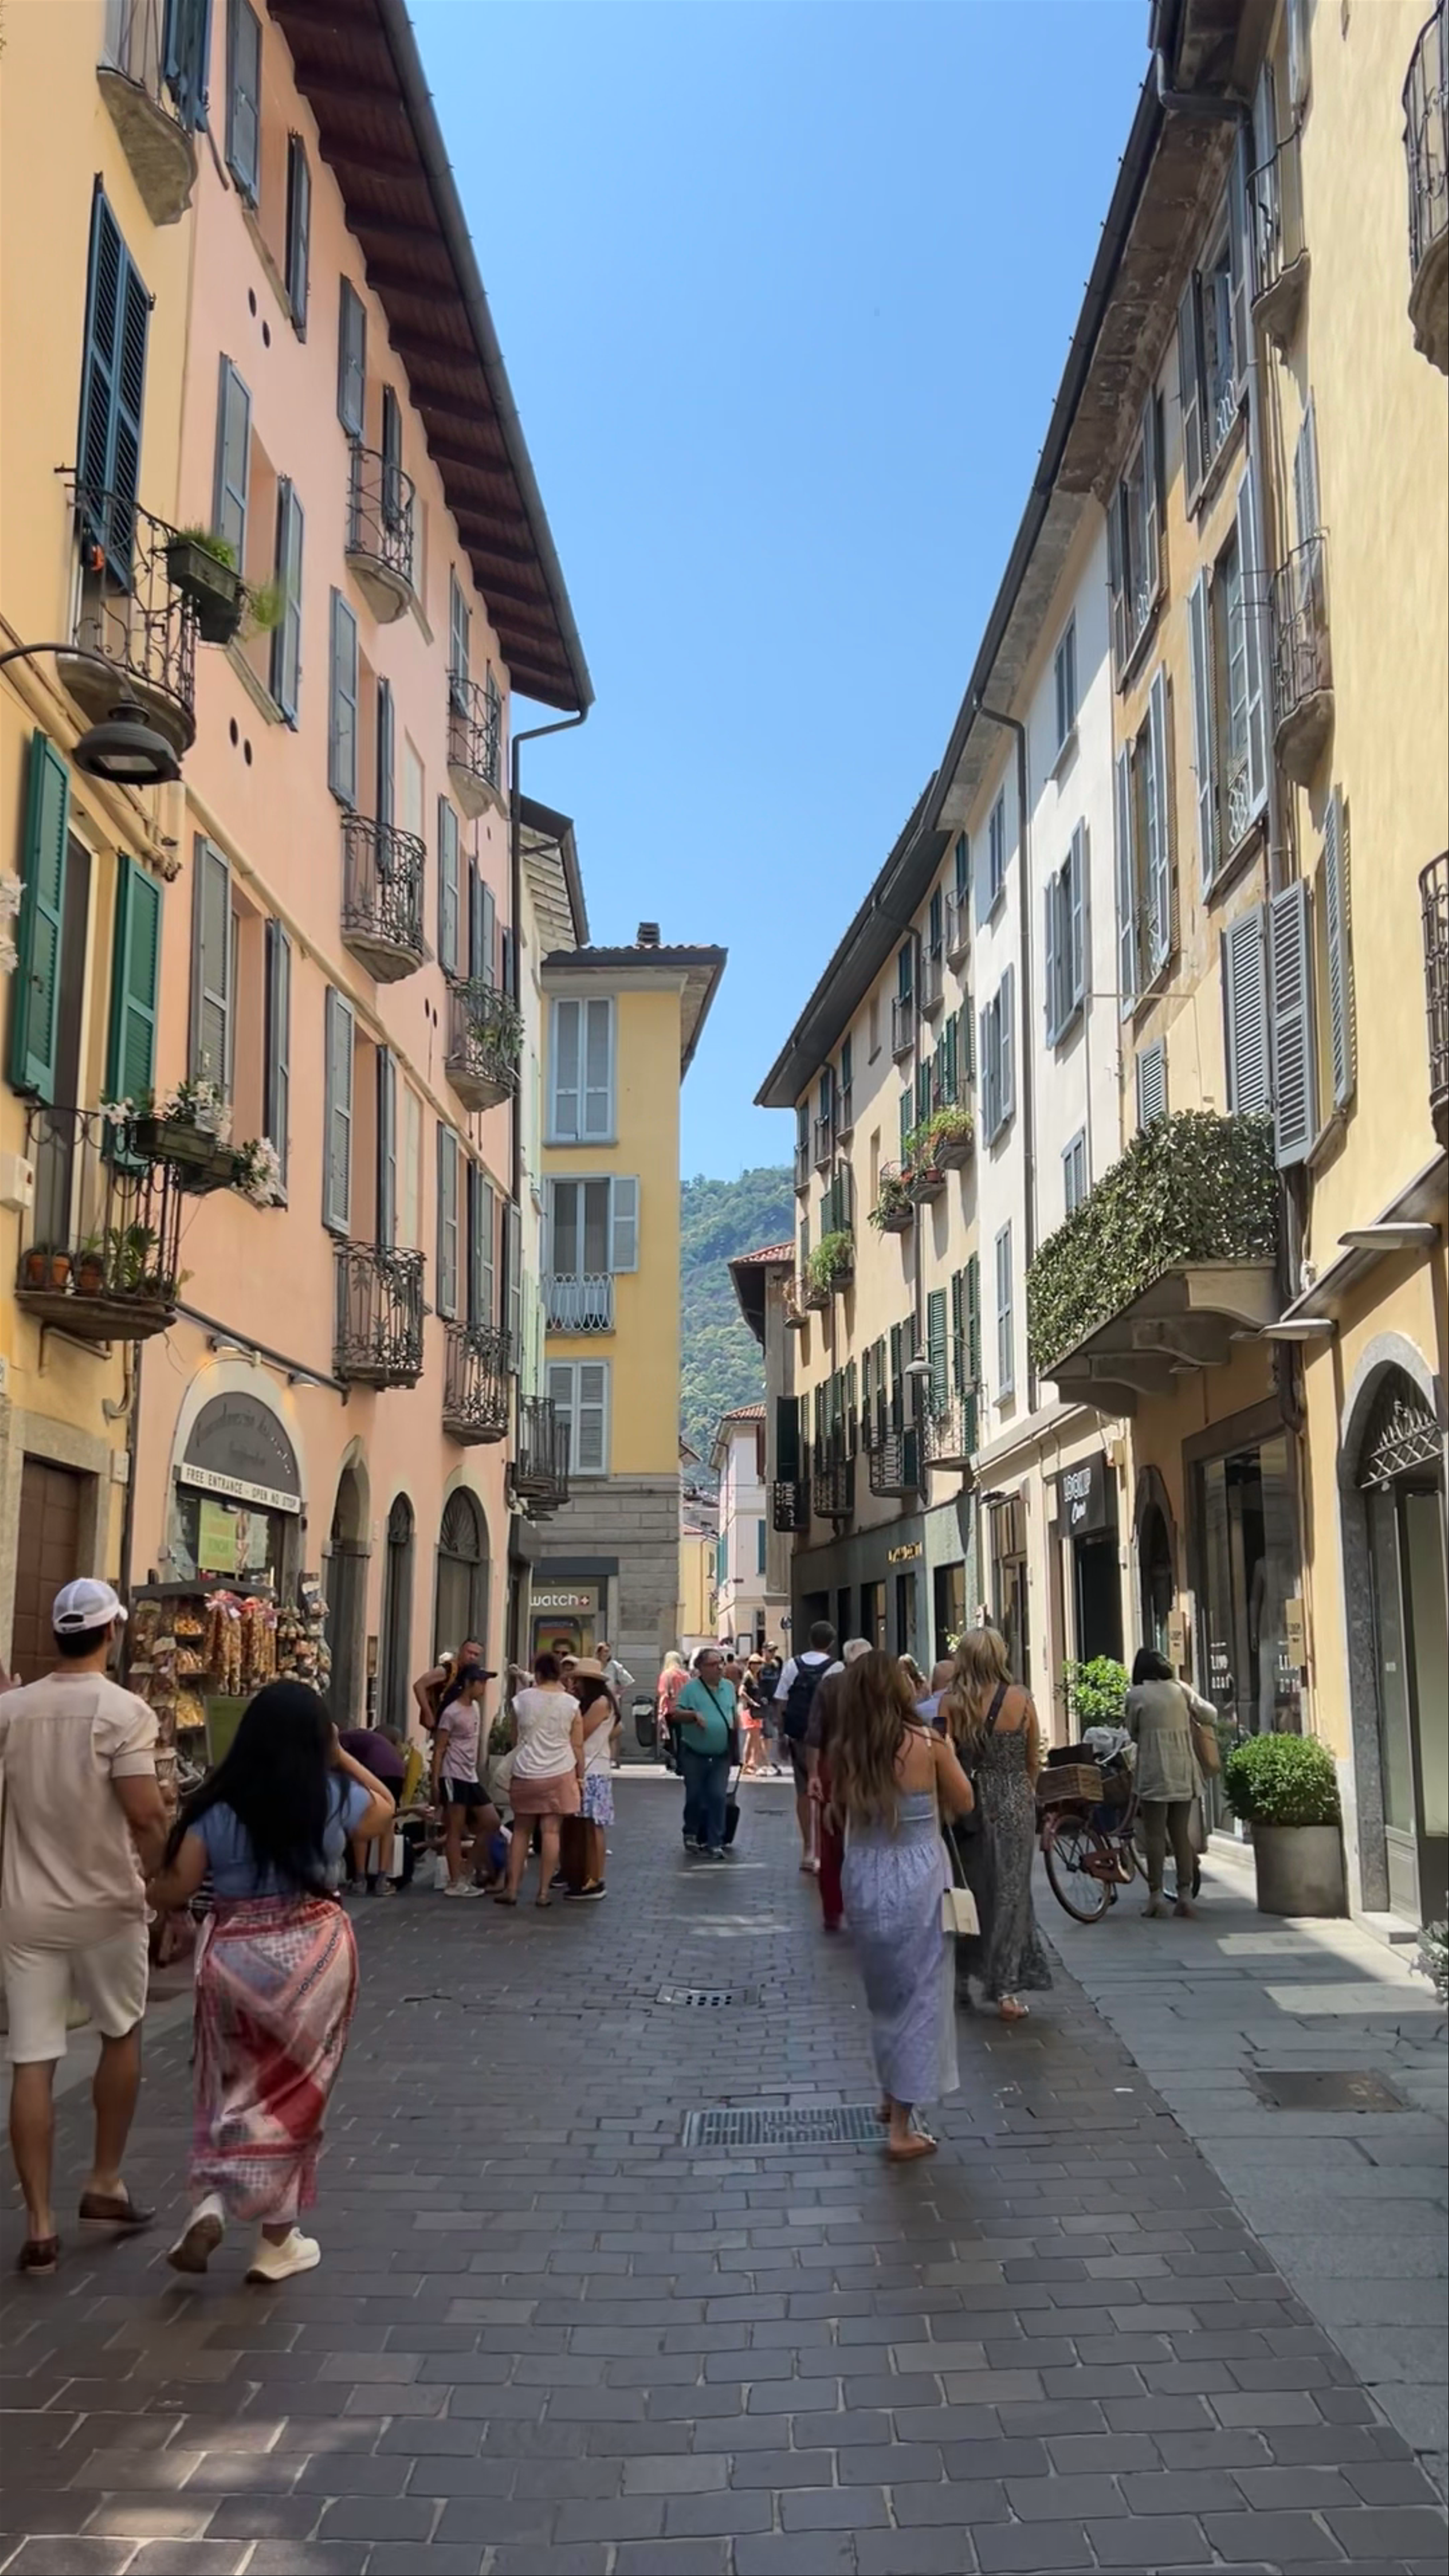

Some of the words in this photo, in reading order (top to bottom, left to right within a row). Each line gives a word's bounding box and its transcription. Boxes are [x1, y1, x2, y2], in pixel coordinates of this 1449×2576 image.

[187, 1467, 204, 1484] FREE
[208, 1474, 243, 1495] ENTRANCE
[252, 1487, 268, 1501] OPEN
[271, 1493, 279, 1505] NO
[282, 1496, 297, 1509] STOP
